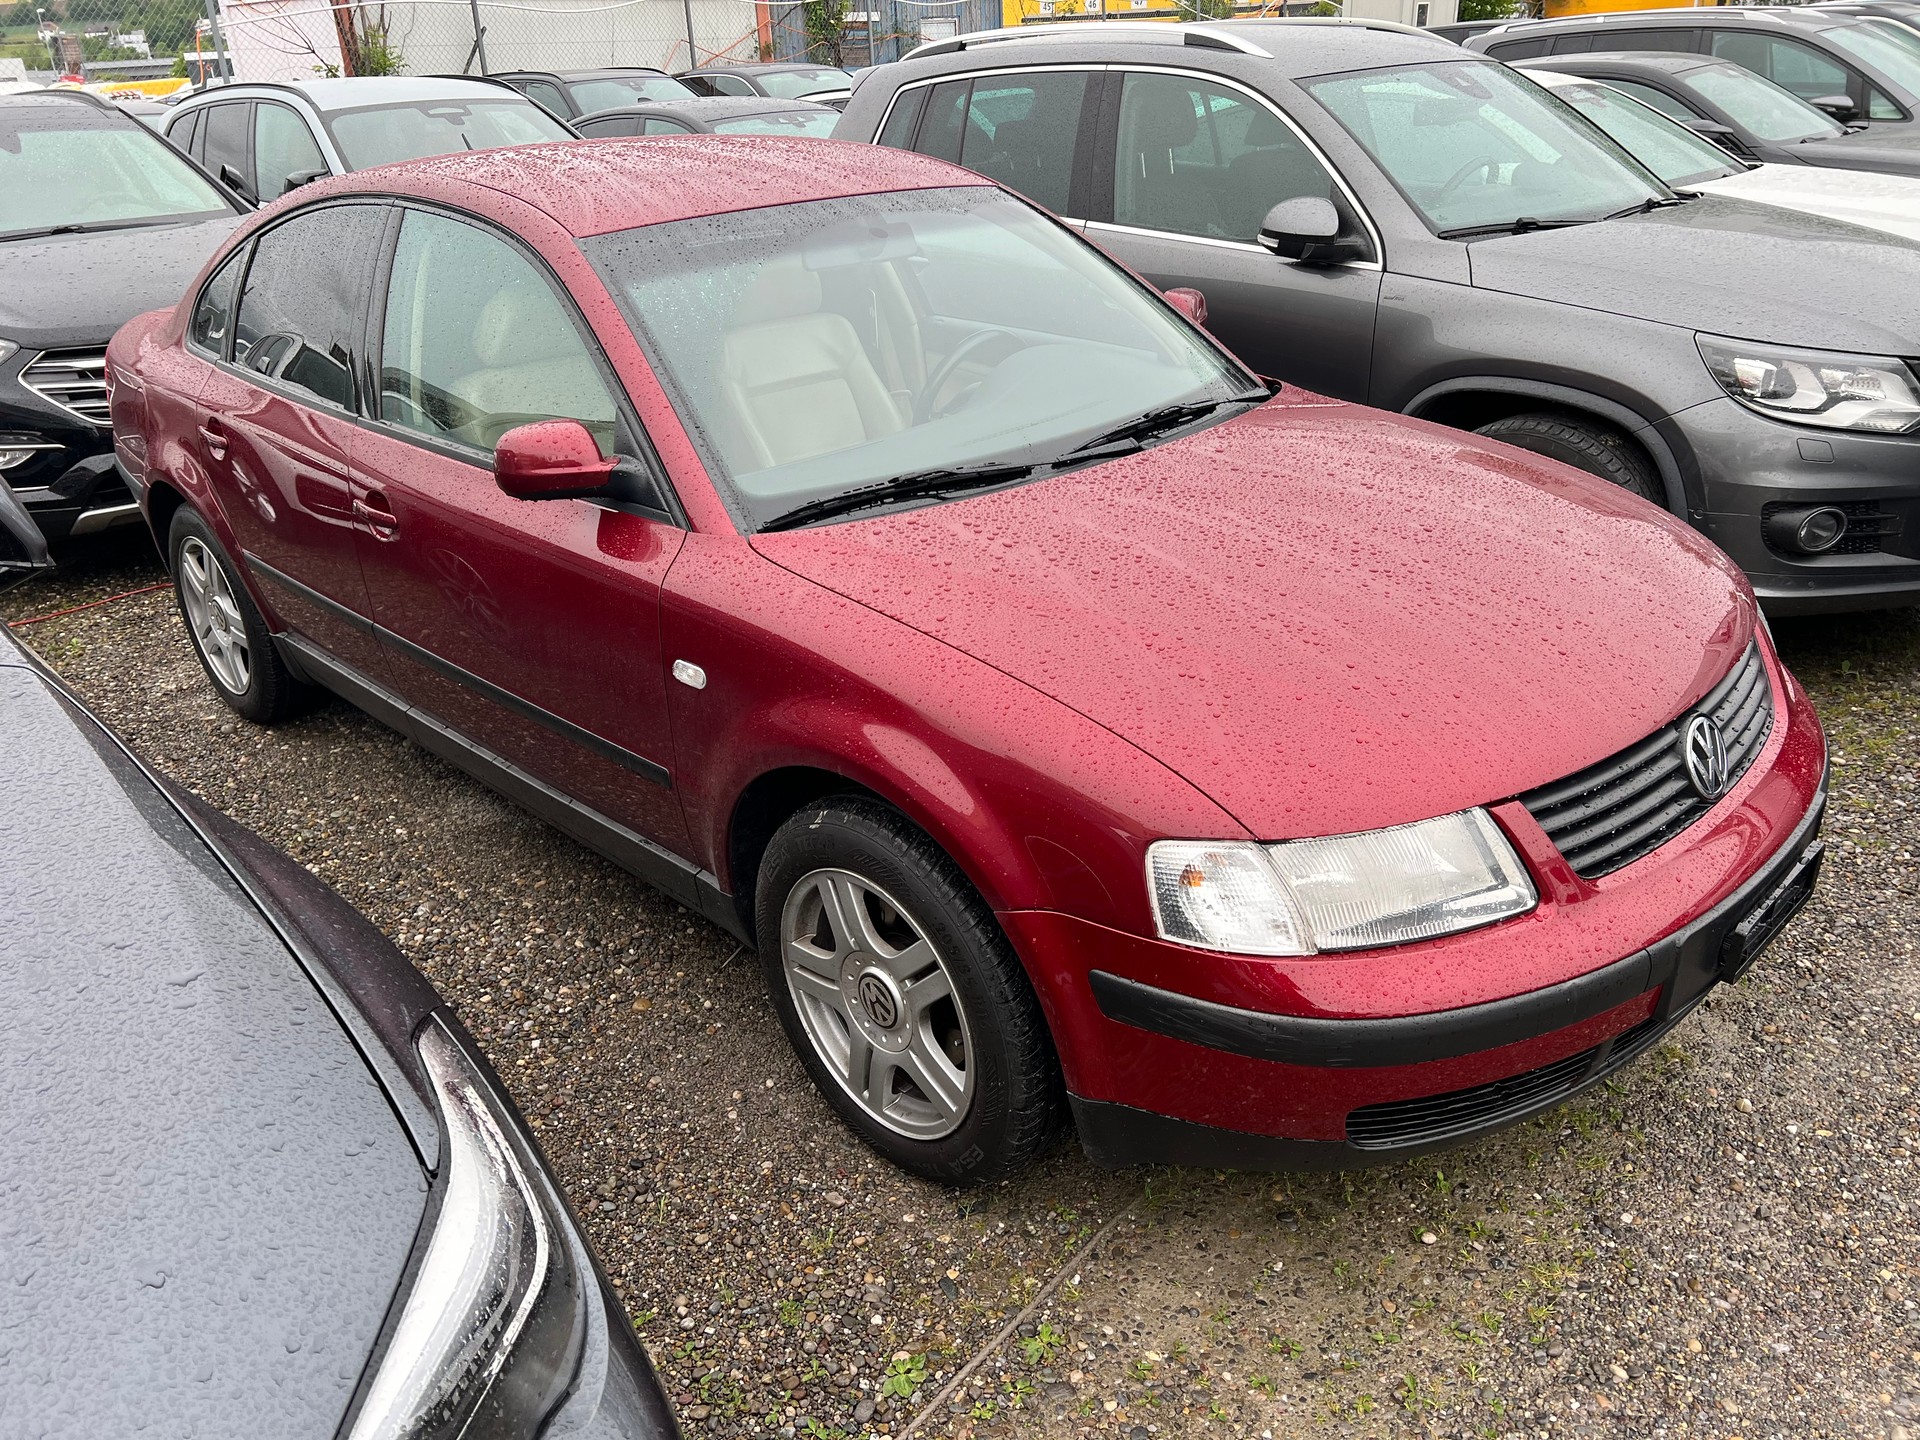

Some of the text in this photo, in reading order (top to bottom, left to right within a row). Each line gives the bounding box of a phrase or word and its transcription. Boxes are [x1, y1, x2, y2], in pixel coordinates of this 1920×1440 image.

[1042, 2, 1051, 11] 45
[1088, 0, 1097, 9] 46
[1686, 716, 1728, 799] VW
[859, 975, 897, 1028] VW
